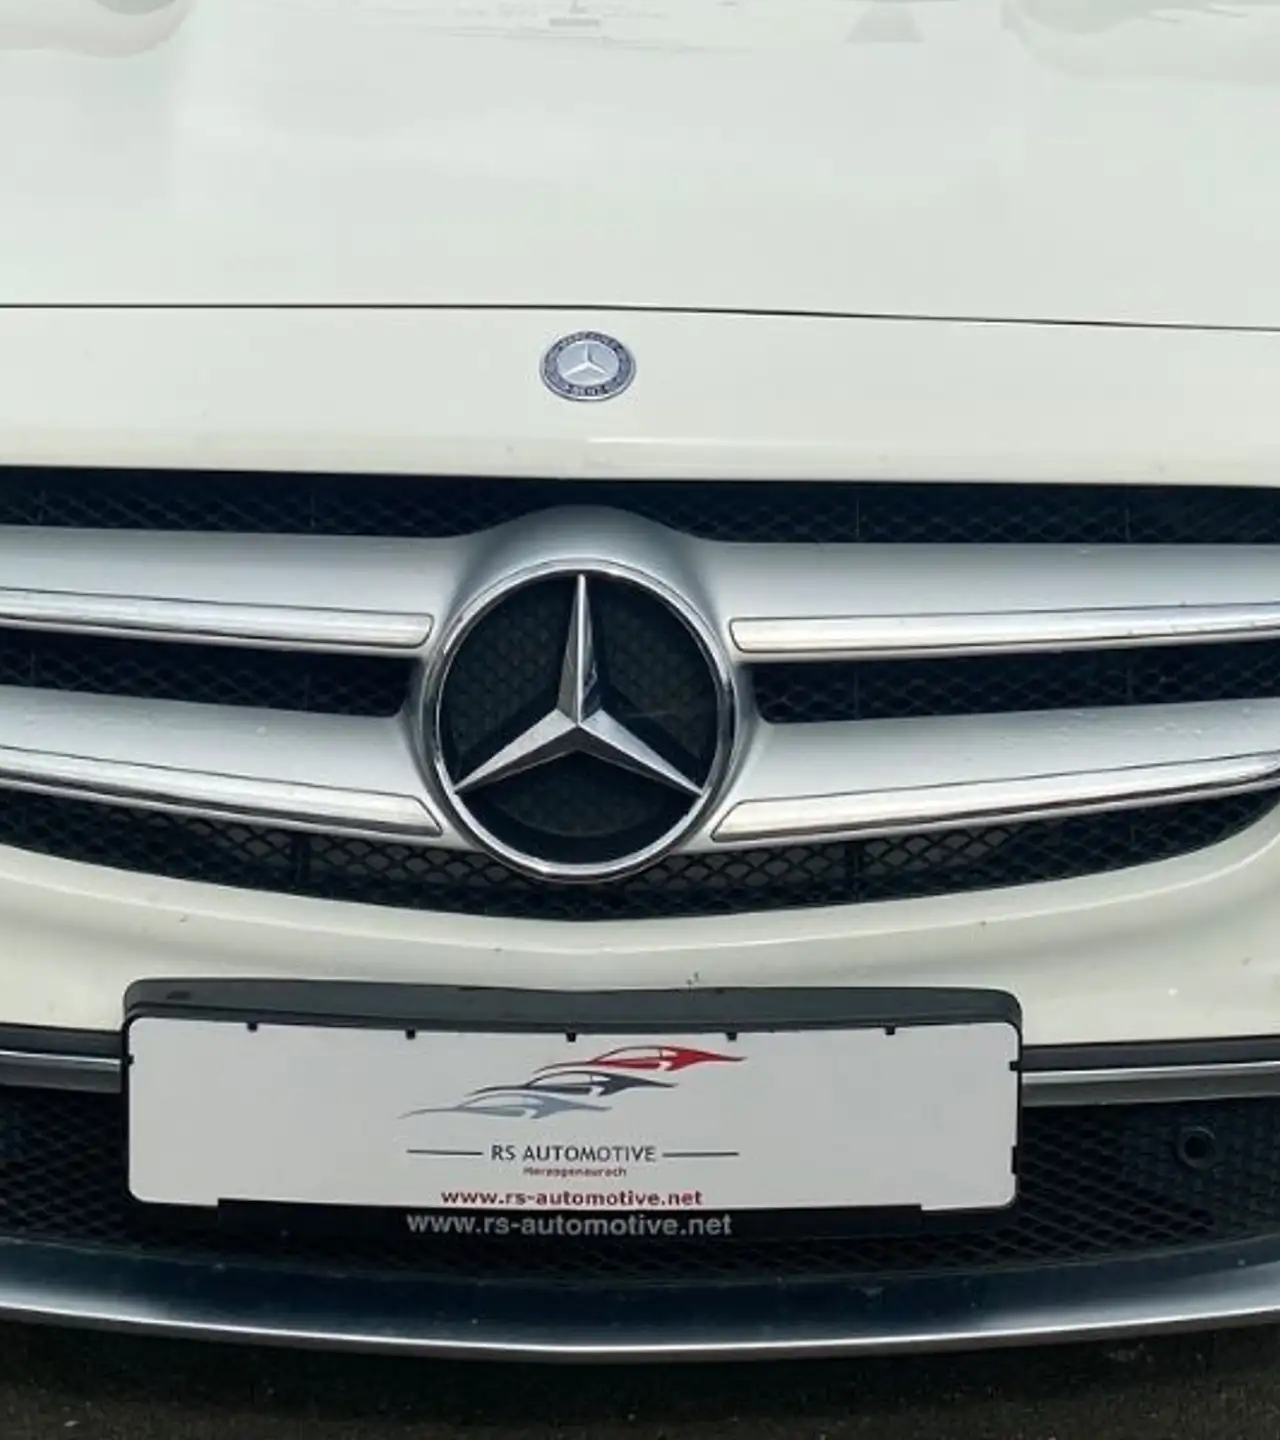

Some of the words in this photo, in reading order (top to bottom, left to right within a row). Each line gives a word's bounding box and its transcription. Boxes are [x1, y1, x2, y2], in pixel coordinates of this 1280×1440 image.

[491, 1145, 515, 1161] RS
[523, 1146, 656, 1162] AUTOMOTIVE
[441, 1190, 703, 1206] www.rs-automotive.net
[407, 1213, 732, 1236] www.rs-automotive.net
